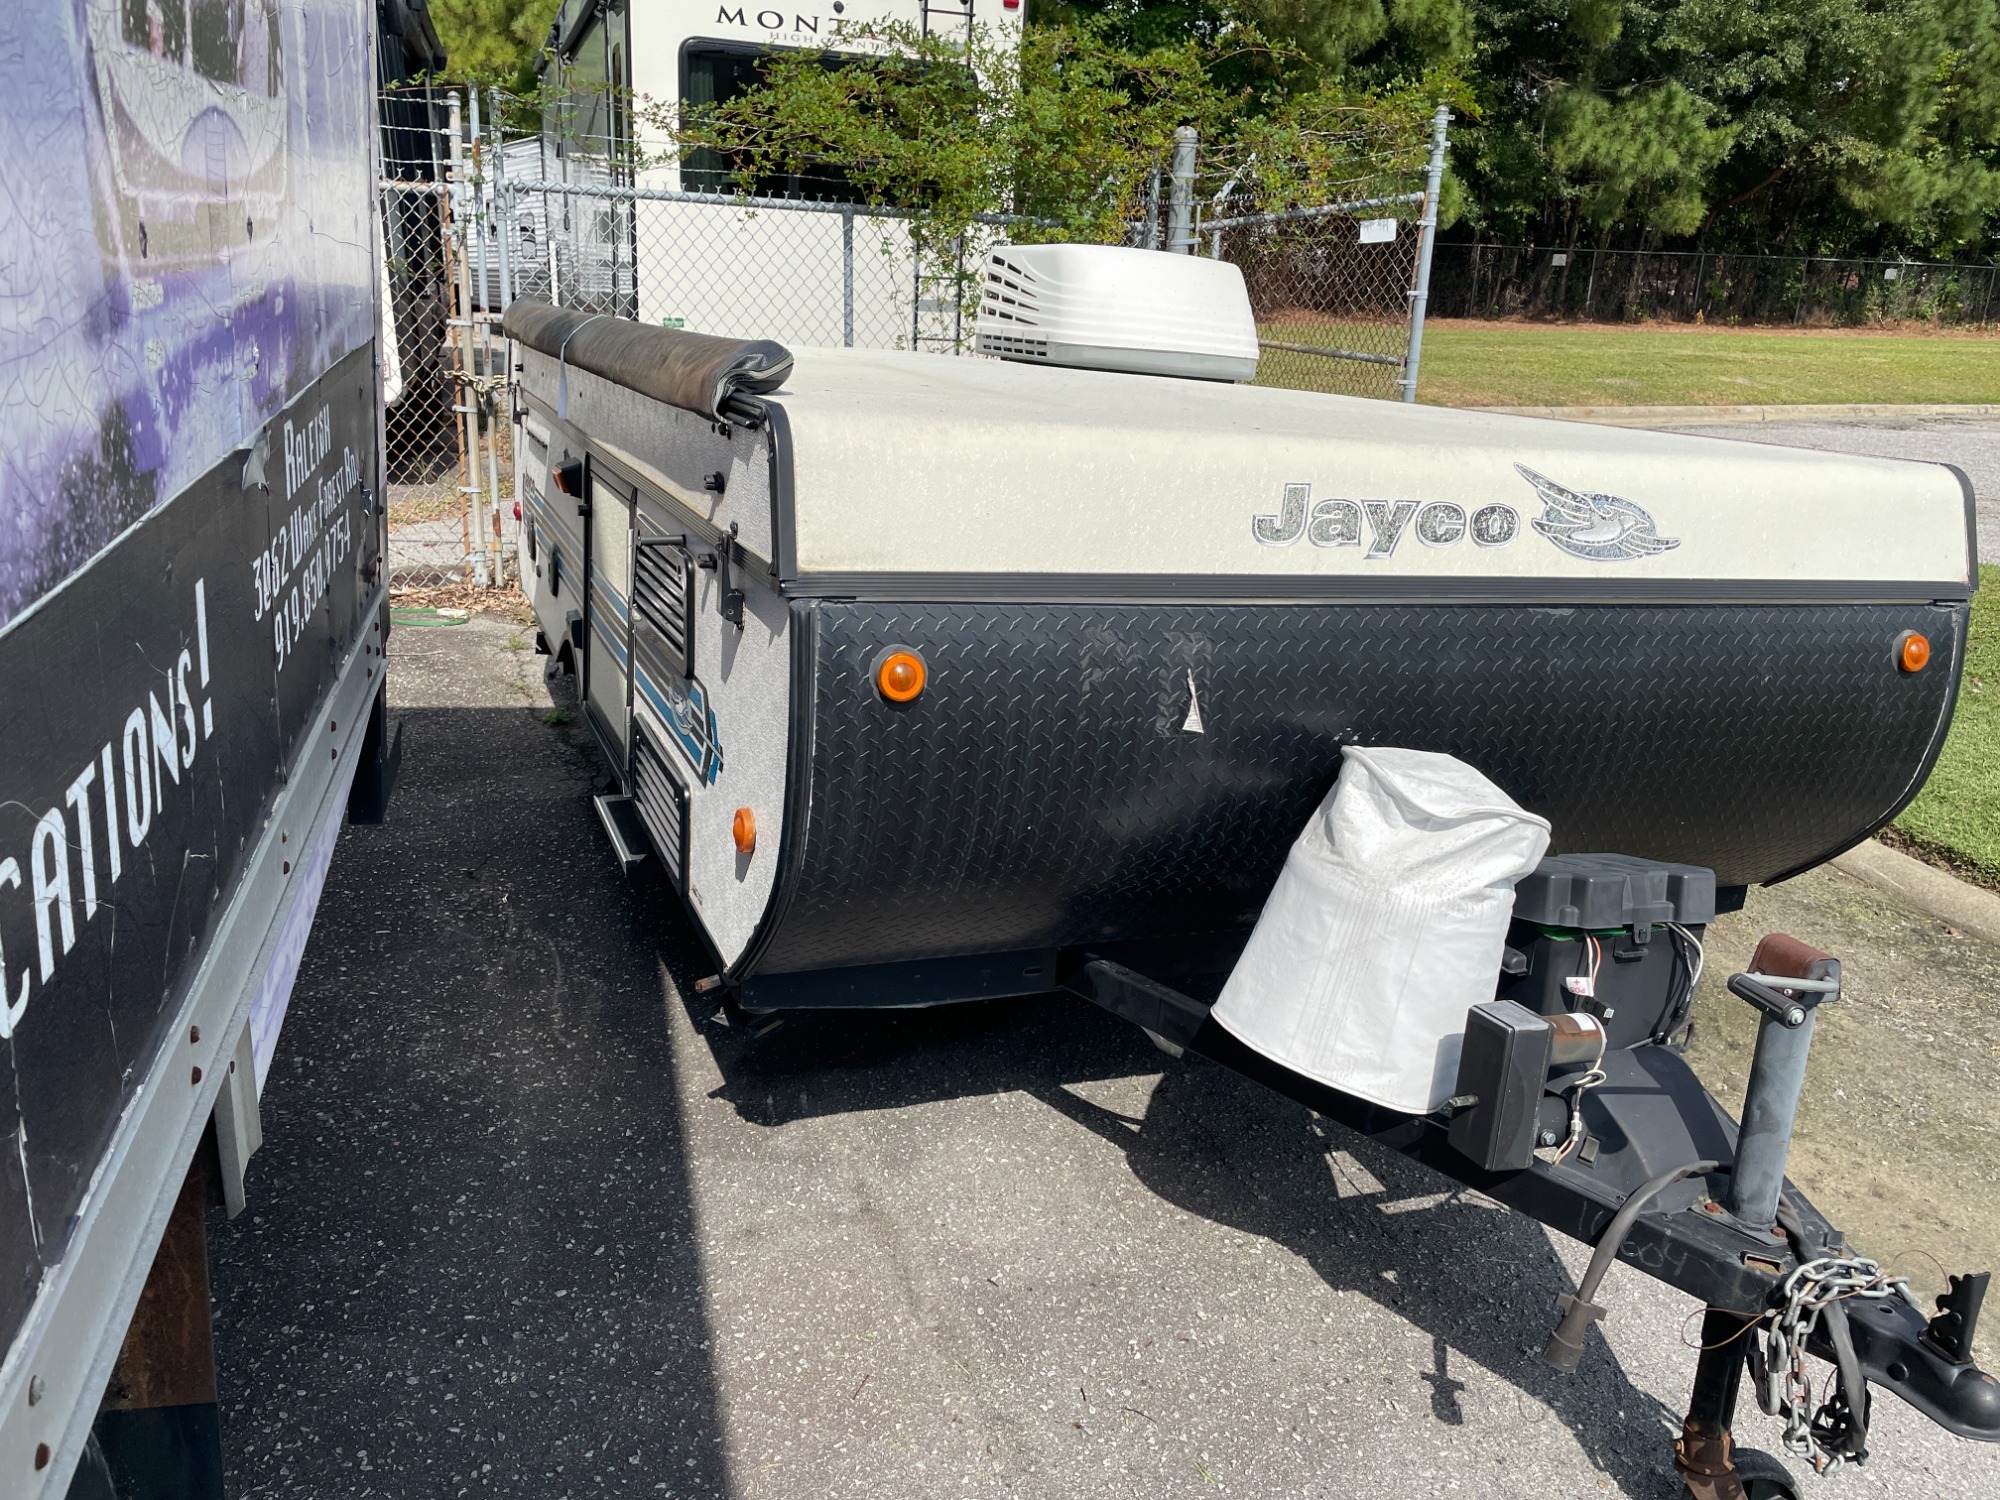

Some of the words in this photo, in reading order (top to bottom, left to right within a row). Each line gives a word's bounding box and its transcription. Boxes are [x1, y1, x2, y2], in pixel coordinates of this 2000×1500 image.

[769, 31, 814, 44] HIGH
[1252, 482, 1521, 561] Jayco
[252, 525, 290, 622] 3062
